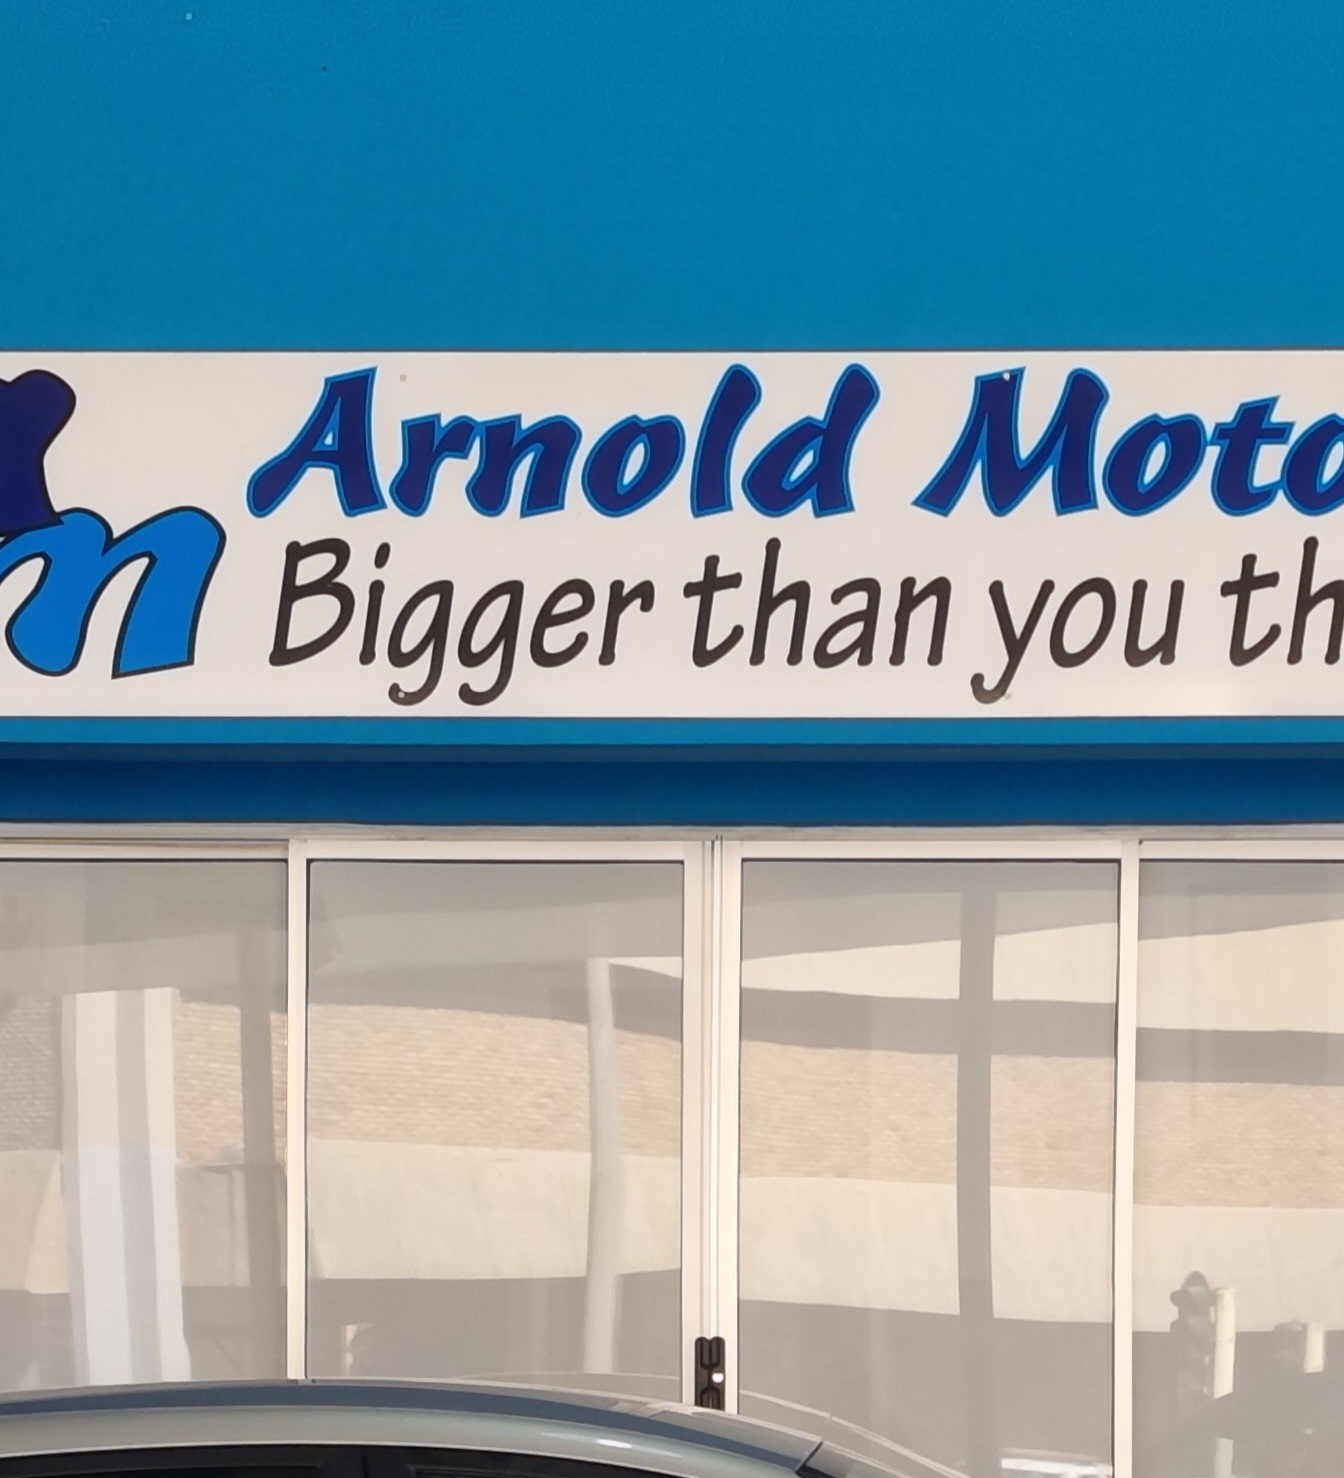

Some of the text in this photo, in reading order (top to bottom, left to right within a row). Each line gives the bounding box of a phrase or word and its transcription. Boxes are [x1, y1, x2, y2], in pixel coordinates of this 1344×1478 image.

[247, 364, 881, 519] Arnold
[269, 537, 655, 706] Bigger
[683, 537, 952, 668] than
[970, 578, 1186, 705] you
